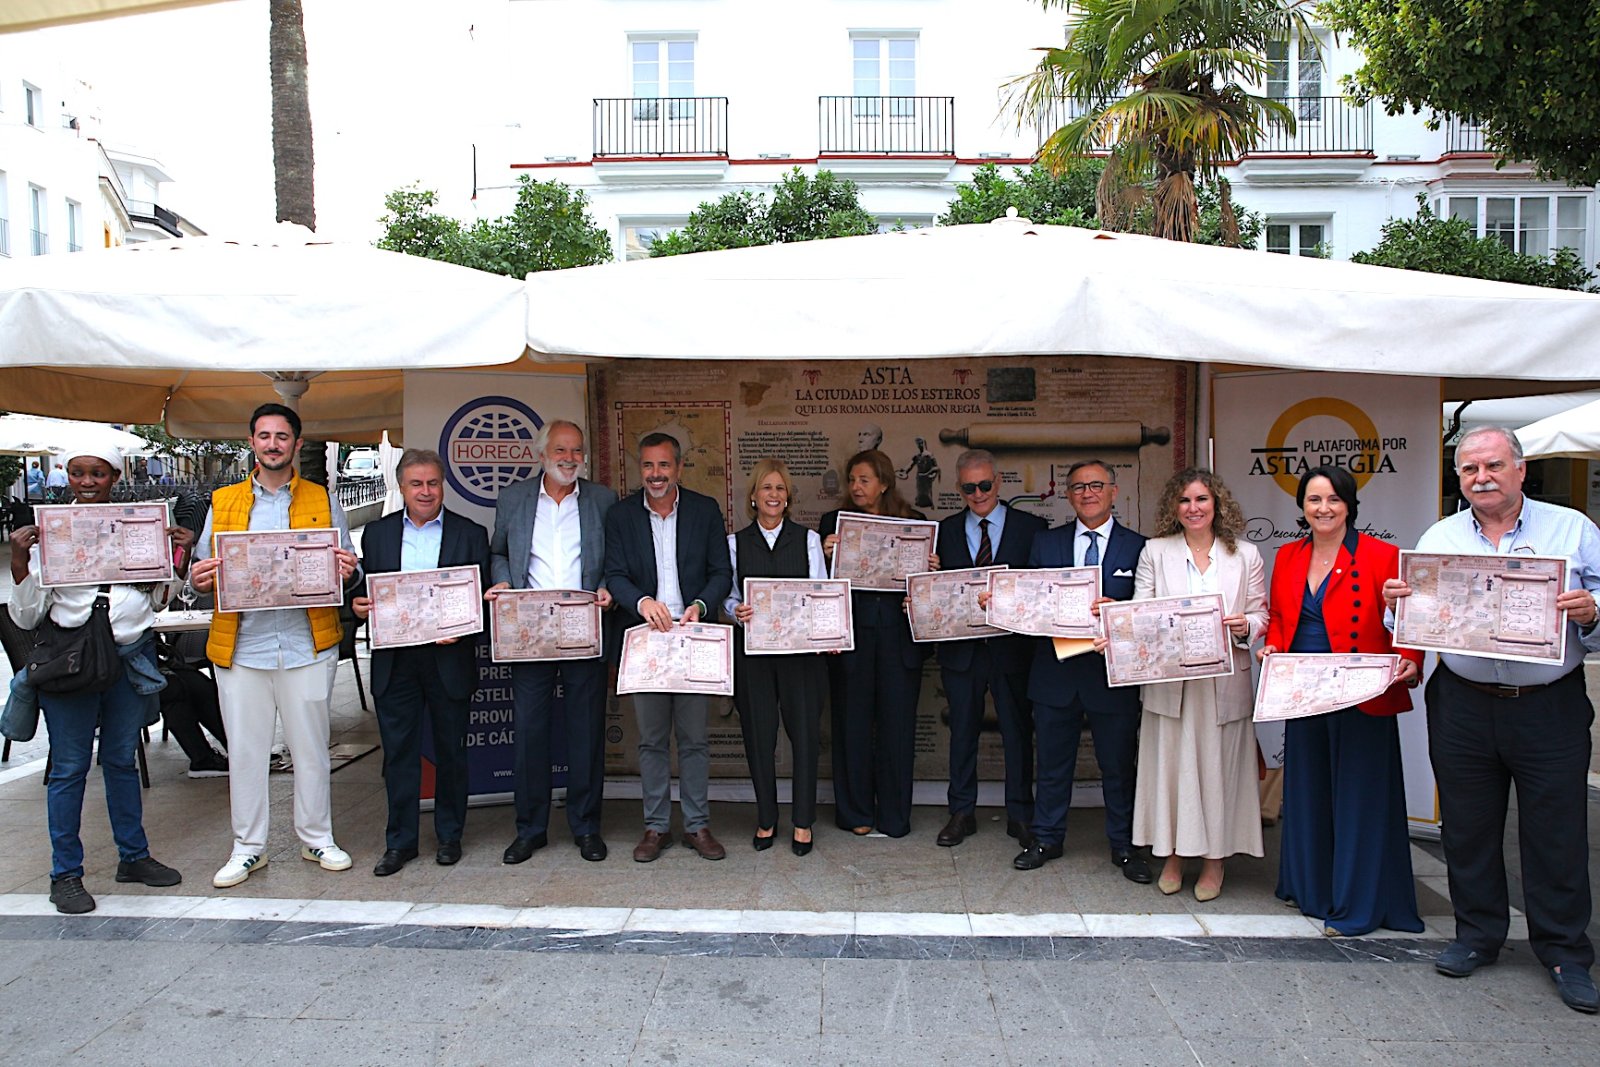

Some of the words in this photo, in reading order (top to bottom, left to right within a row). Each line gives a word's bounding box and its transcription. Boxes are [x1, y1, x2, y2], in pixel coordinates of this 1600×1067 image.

[861, 366, 914, 385] ASTA
[796, 390, 813, 400] LA
[816, 389, 868, 400] CIUDAD
[872, 389, 889, 400] DE
[892, 388, 918, 400] LOS
[920, 388, 980, 400] ESTEROS
[795, 405, 816, 416] QUE
[818, 405, 838, 414] LOS
[840, 404, 890, 414] ROMANOS
[891, 404, 948, 414] LLAMARON
[950, 404, 982, 414] REGIA
[458, 444, 533, 459] HORECA
[1304, 438, 1380, 452] PLATAFORMA
[1382, 438, 1407, 450] POR
[1248, 456, 1310, 476] ASTA
[1320, 454, 1397, 474] REGIA
[1246, 517, 1312, 542] Descubr
[470, 710, 512, 724] PROVI
